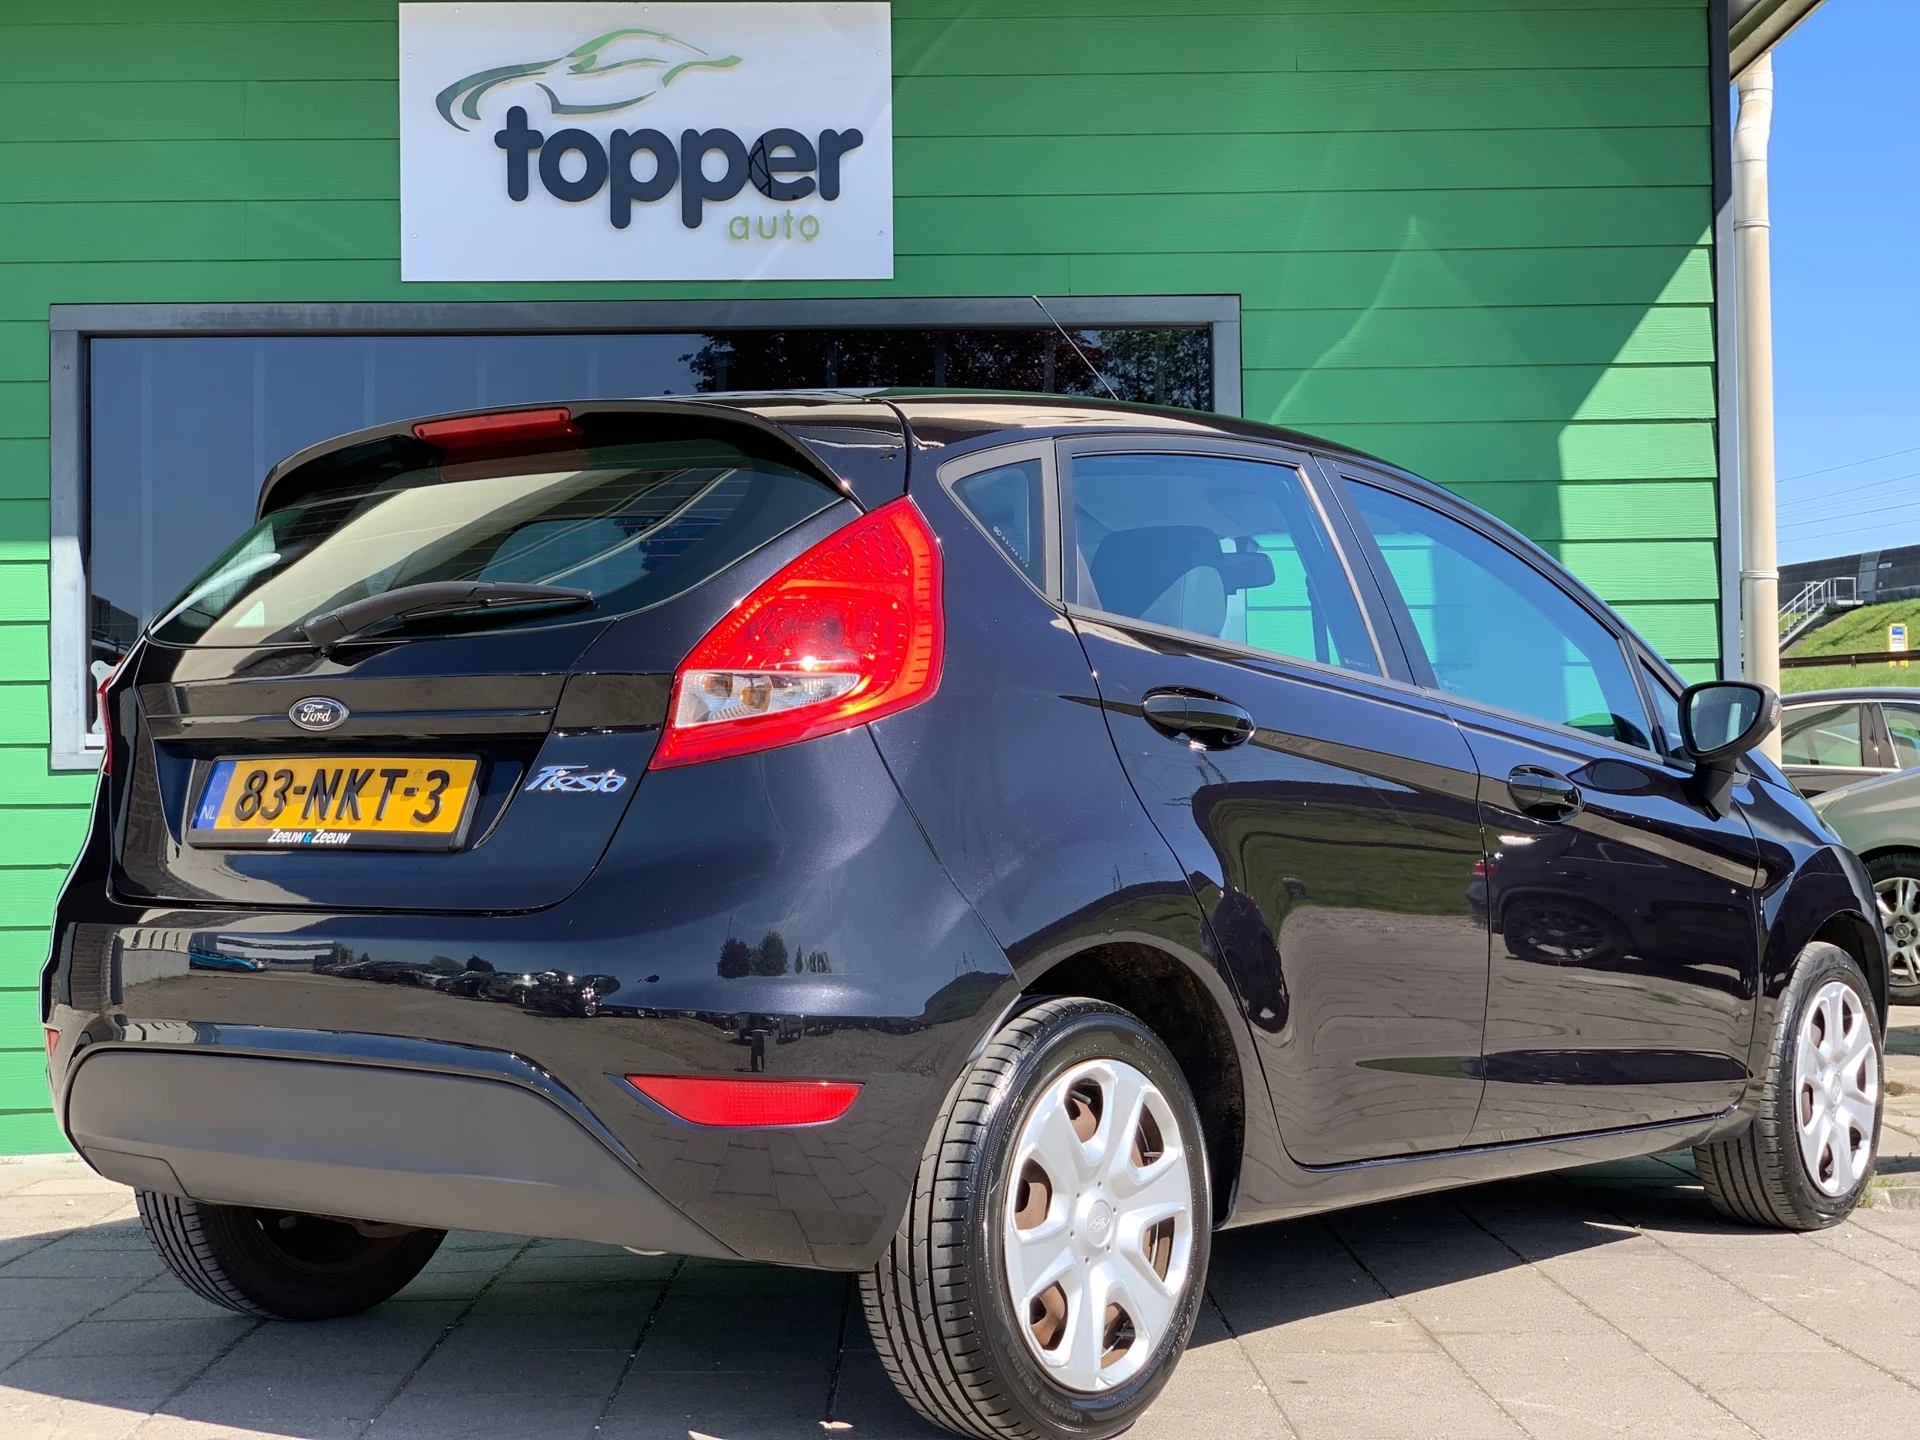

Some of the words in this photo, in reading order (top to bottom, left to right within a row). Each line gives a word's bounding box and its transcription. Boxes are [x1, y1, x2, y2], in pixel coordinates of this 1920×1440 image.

[494, 106, 864, 229] topper
[728, 210, 820, 242] auto
[301, 703, 332, 722] Ford
[525, 765, 627, 793] Fiesta
[234, 769, 451, 823] 83-NKT-3
[199, 805, 215, 820] NL
